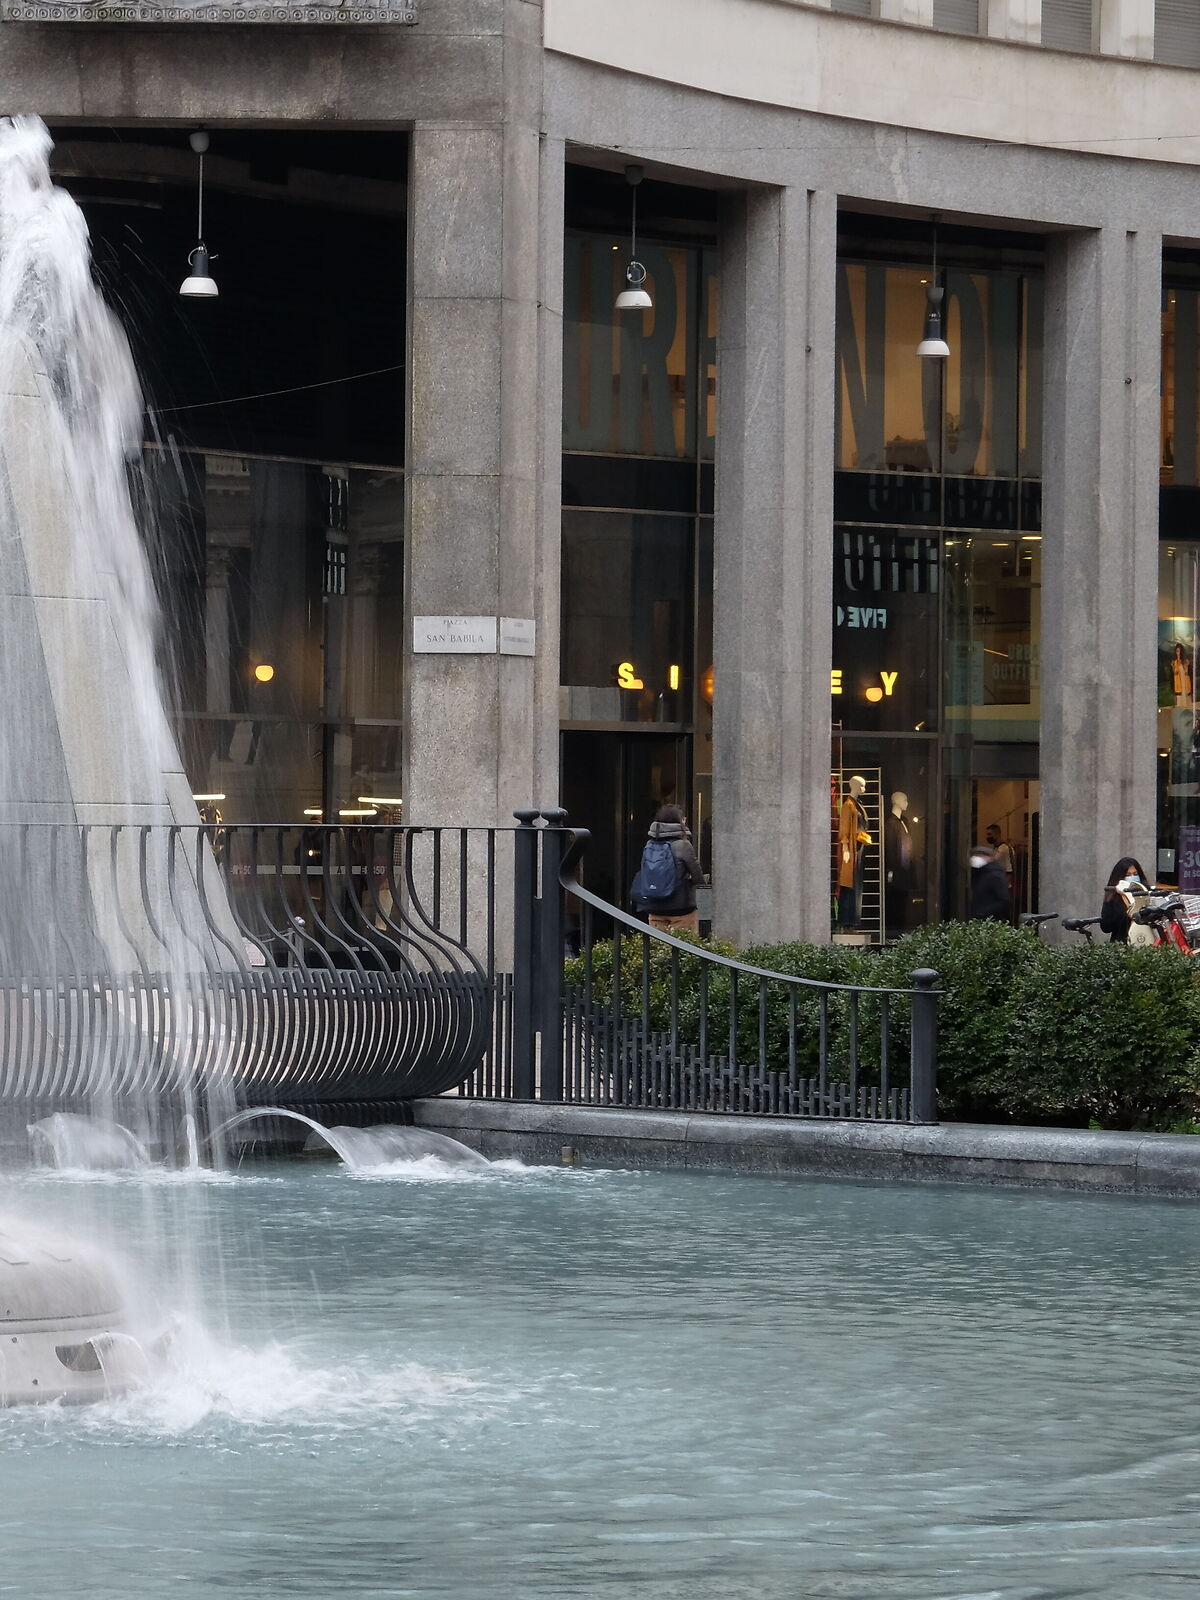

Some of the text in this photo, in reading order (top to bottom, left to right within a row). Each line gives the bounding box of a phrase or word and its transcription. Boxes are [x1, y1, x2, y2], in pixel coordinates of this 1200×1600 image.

[426, 634, 484, 643] SAN BABILA
[617, 662, 898, 696] SIEY
